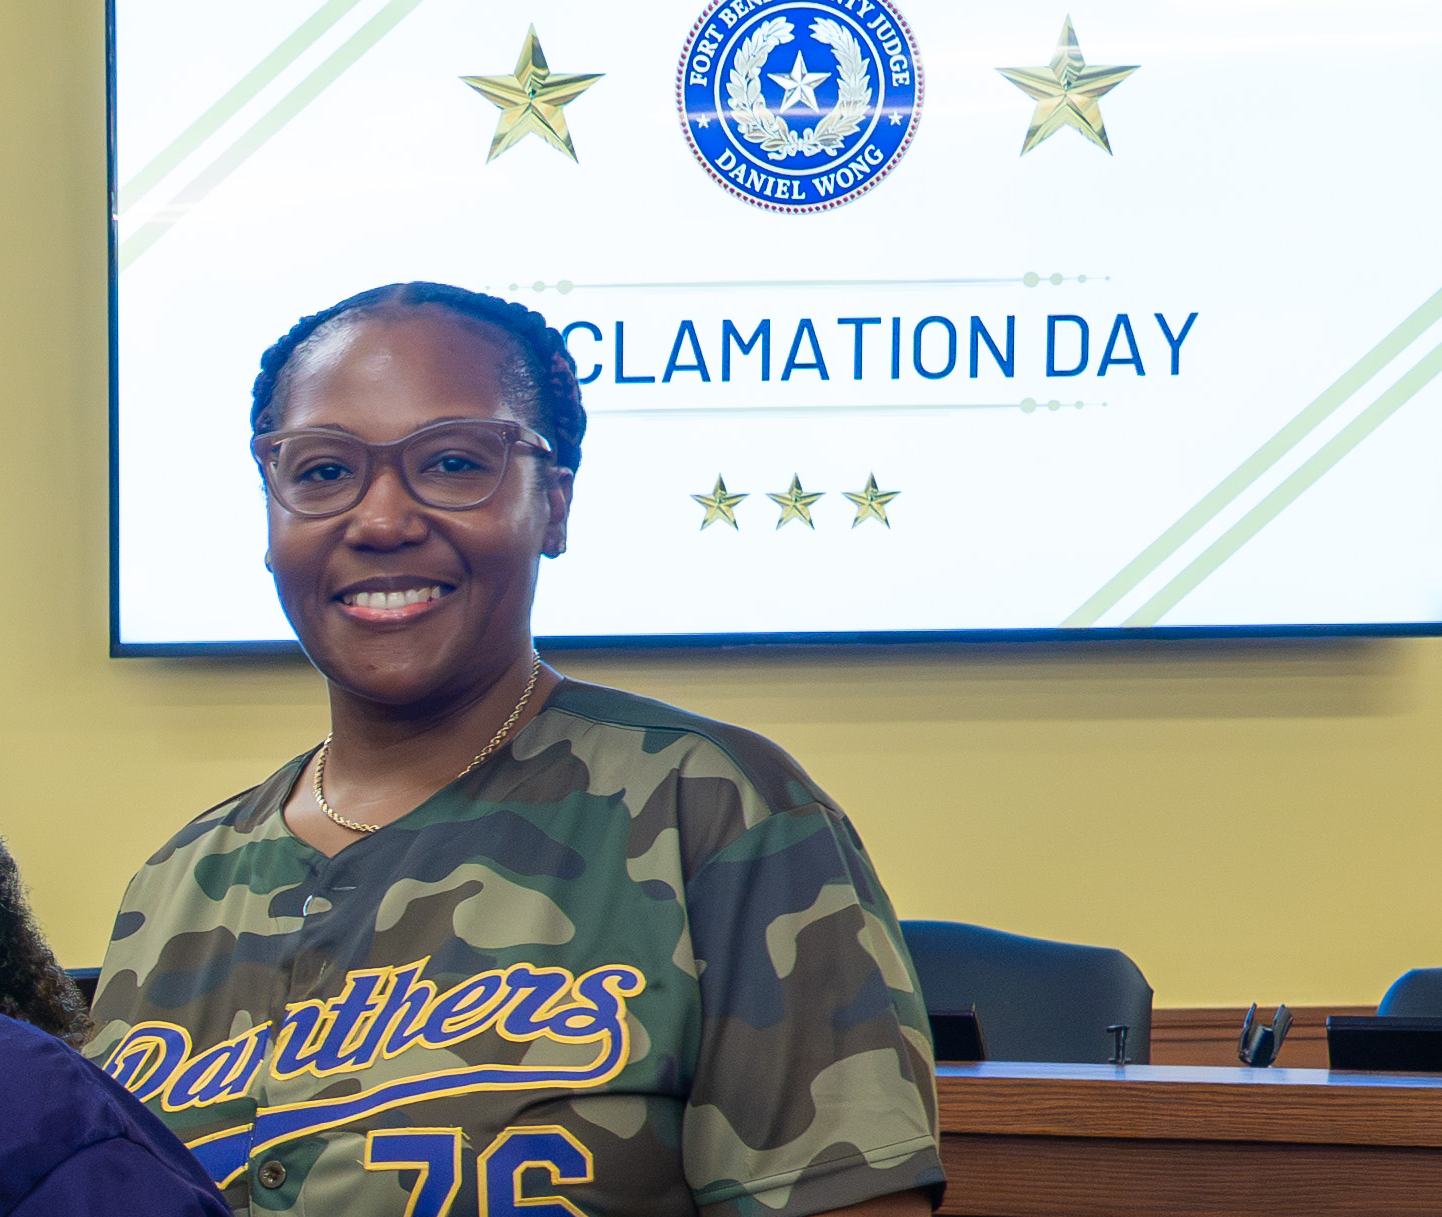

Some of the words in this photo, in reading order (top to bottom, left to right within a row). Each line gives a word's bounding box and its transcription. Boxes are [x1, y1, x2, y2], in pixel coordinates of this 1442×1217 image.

[689, 24, 725, 87] FORT
[867, 13, 910, 87] JUDGE
[714, 147, 806, 200] DANIEL
[812, 143, 885, 198] WONG
[561, 314, 1017, 386] CLAMATION
[1045, 312, 1199, 379] DAY
